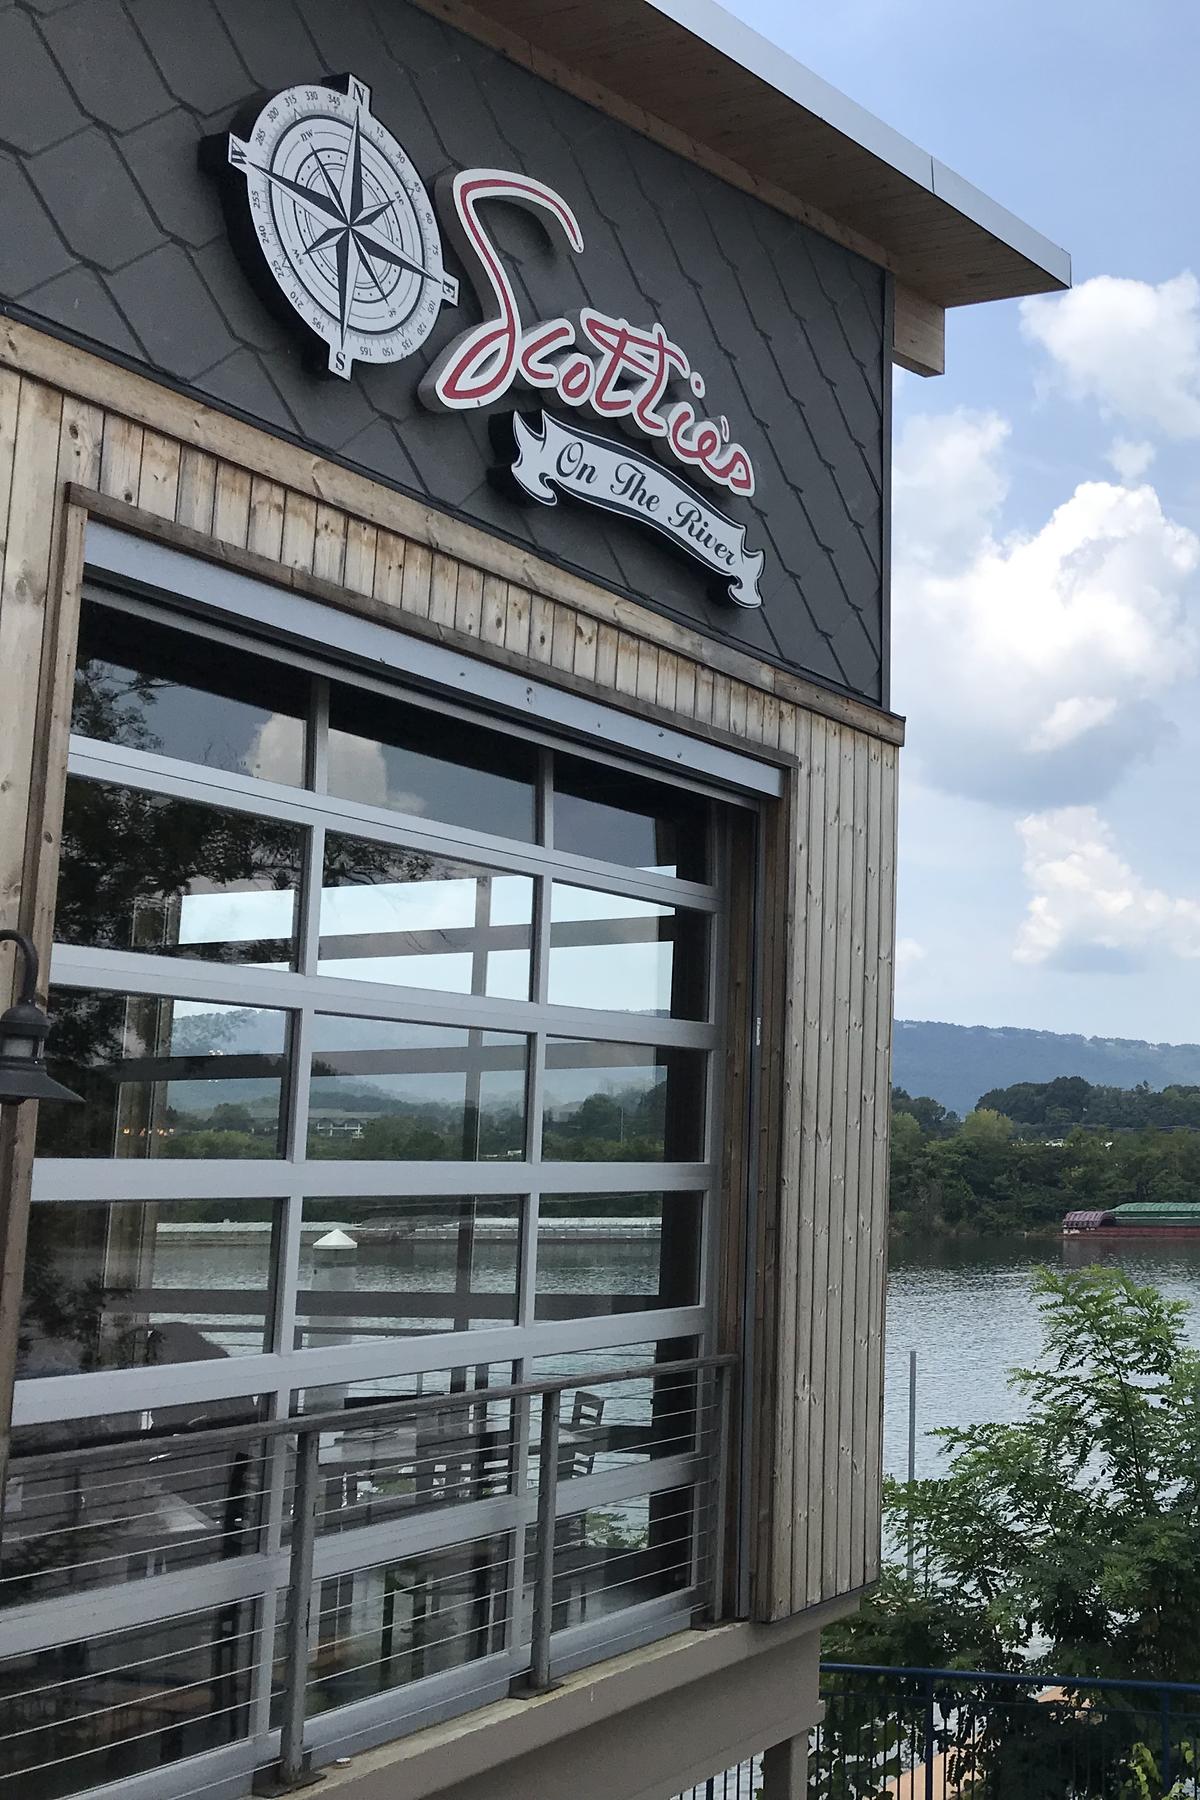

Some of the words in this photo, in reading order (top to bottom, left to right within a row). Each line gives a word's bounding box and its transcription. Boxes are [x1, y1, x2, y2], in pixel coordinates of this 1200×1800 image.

[284, 94, 297, 107] 315
[305, 91, 318, 101] 330
[328, 93, 341, 106] 345
[352, 82, 365, 106] N
[267, 107, 279, 122] 300
[255, 129, 266, 146] 285
[231, 138, 248, 165] W
[396, 151, 406, 164] 30
[414, 181, 421, 193] 45
[252, 190, 260, 209] 255
[425, 212, 433, 224] 60
[257, 225, 270, 244] 240
[432, 244, 439, 256] 75
[272, 259, 285, 279] 225
[443, 280, 455, 299] E
[290, 291, 304, 309] 210
[427, 300, 436, 315] 105
[311, 317, 324, 332] 195
[417, 323, 427, 336] 120
[360, 346, 372, 356] 165
[382, 347, 394, 356] 150
[401, 338, 413, 350] 135
[335, 351, 346, 371] S
[556, 441, 598, 485] On
[610, 462, 660, 512] The
[667, 500, 737, 566] River
